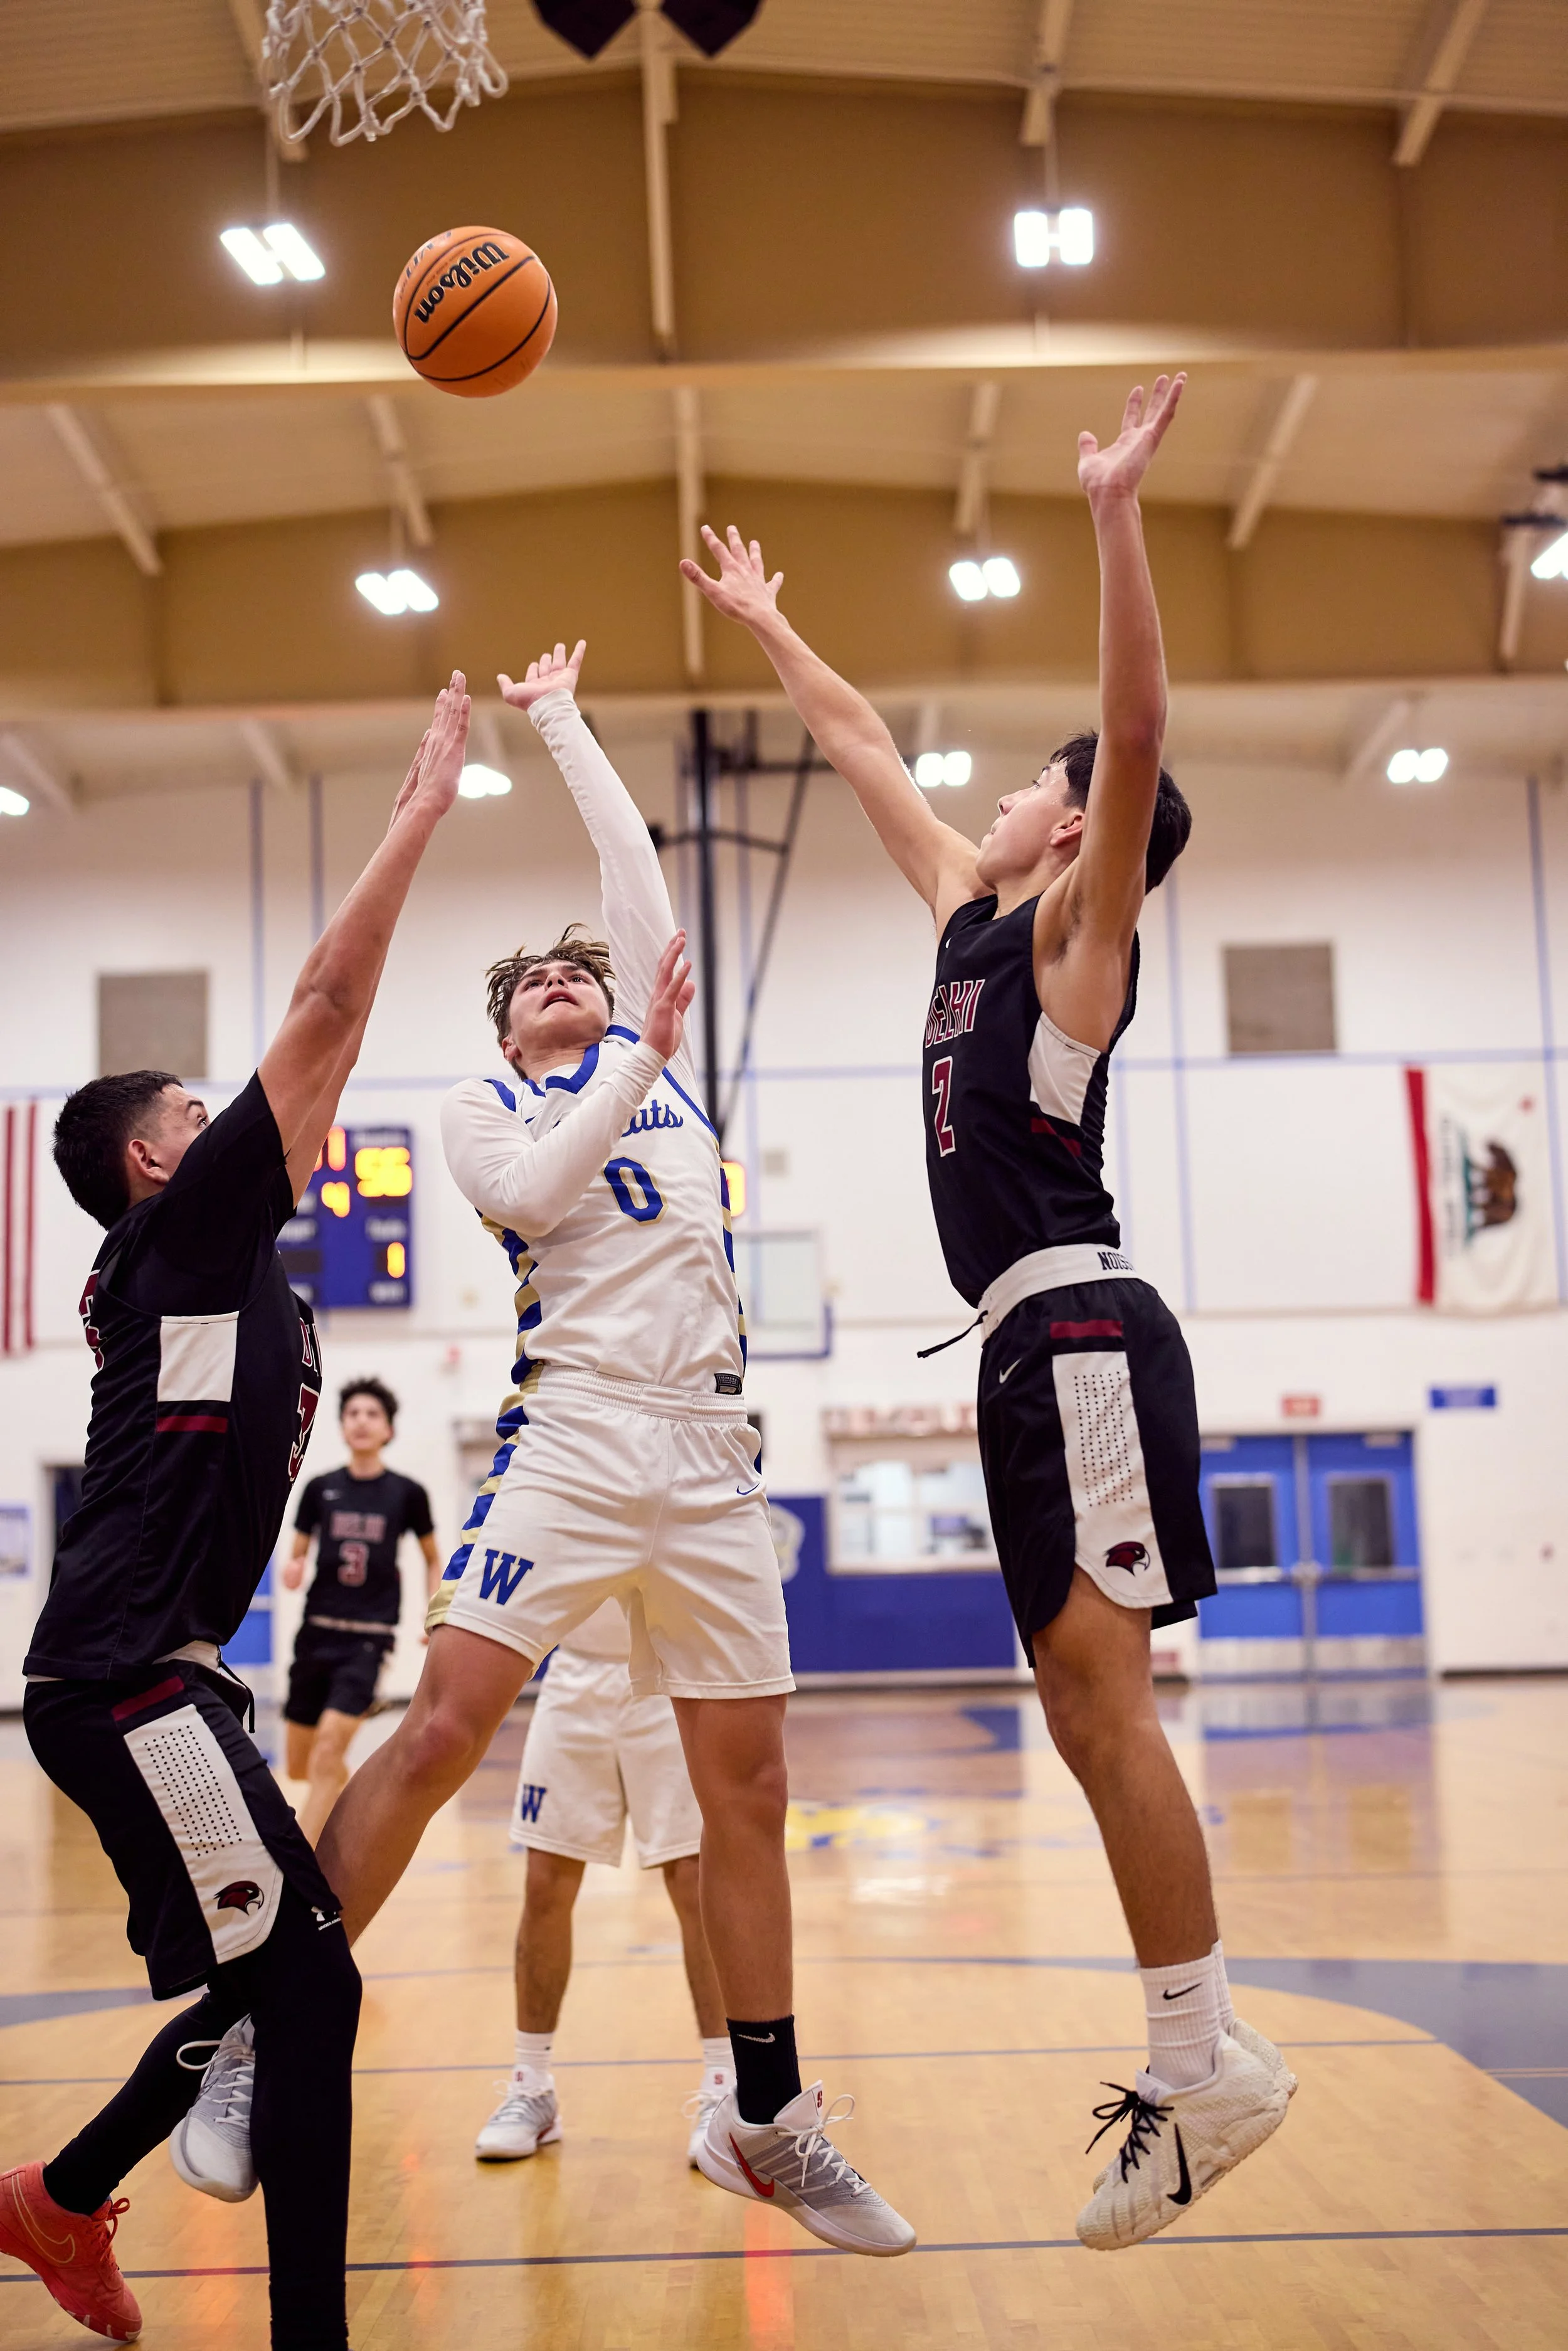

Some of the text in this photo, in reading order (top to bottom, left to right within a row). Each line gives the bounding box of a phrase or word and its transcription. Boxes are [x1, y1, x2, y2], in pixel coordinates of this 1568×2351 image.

[414, 241, 510, 324] Wilson
[925, 979, 985, 1048] DELHI
[932, 1056, 956, 1157] 2
[602, 1154, 668, 1226] 0
[479, 1548, 536, 1606] W
[522, 1784, 548, 1823] W
